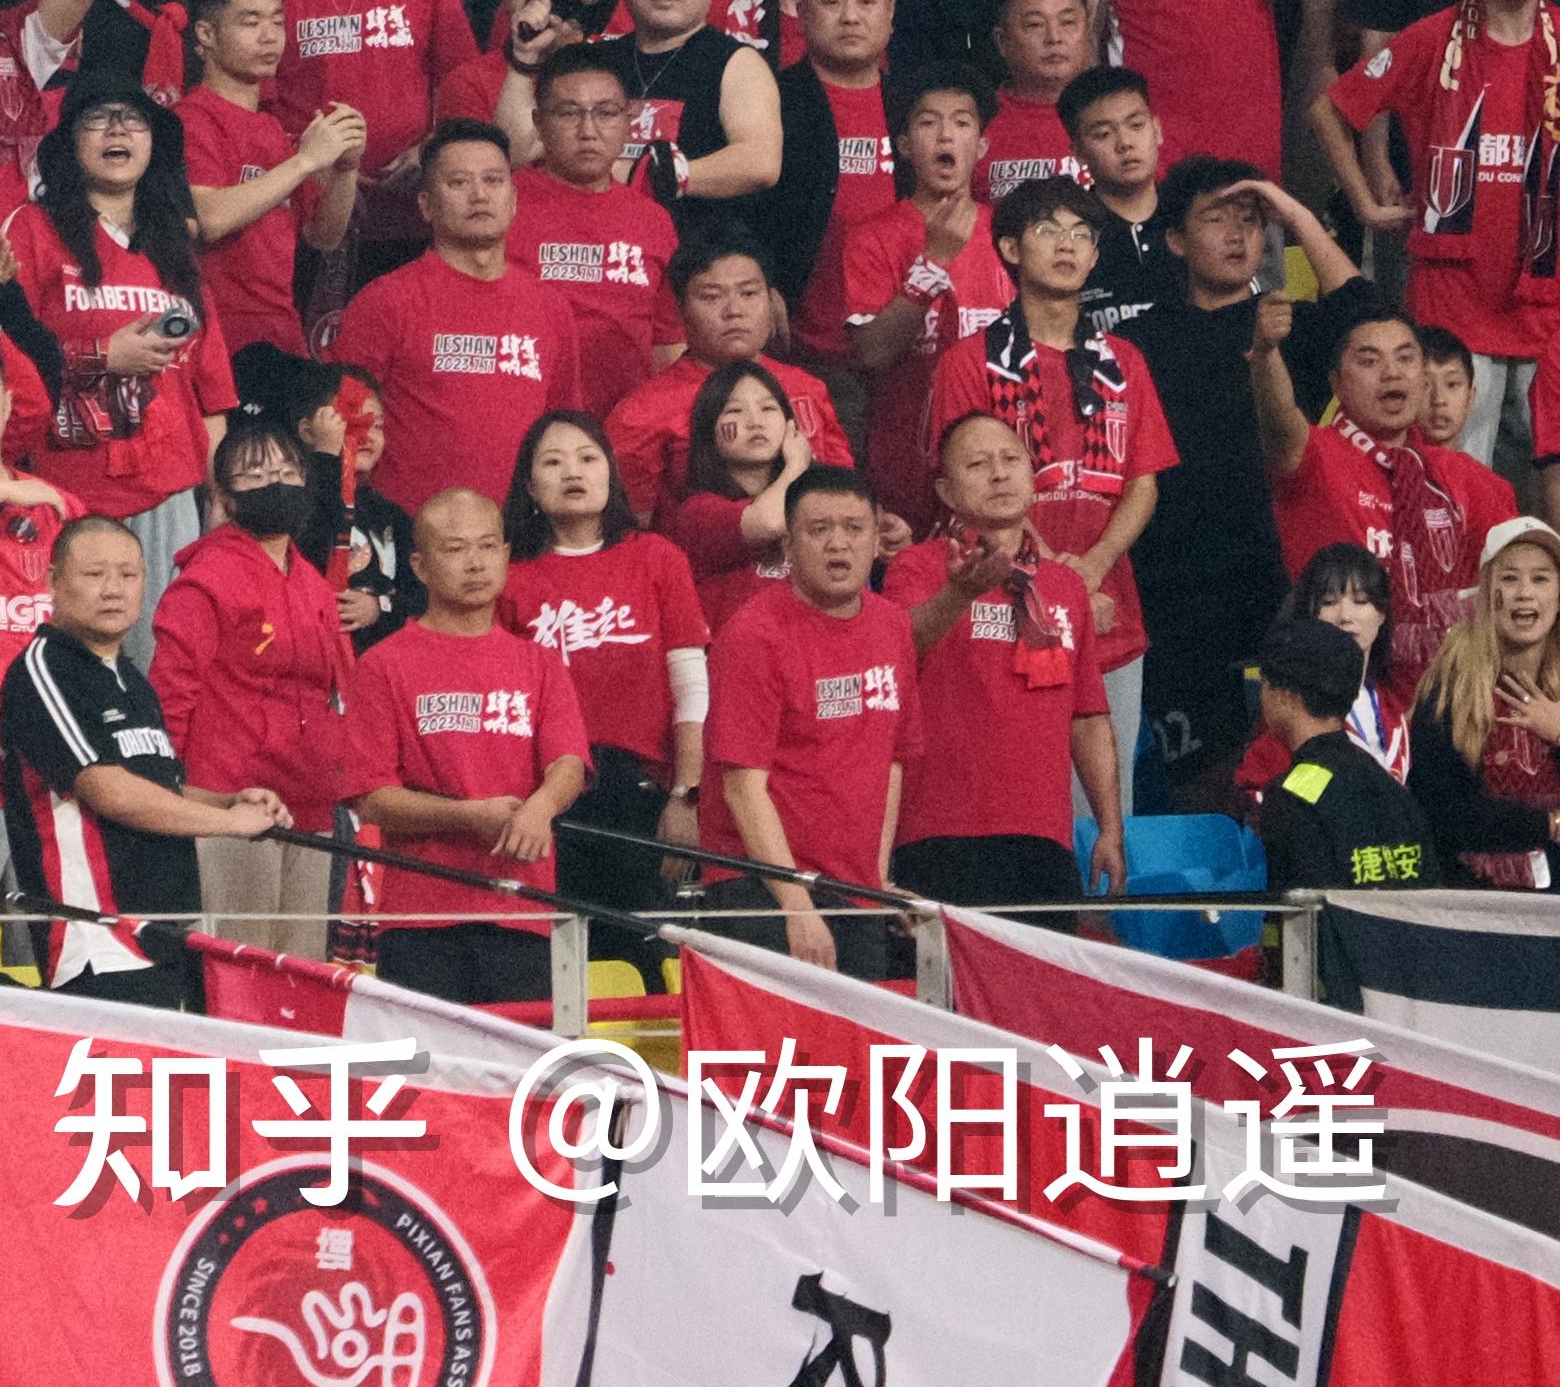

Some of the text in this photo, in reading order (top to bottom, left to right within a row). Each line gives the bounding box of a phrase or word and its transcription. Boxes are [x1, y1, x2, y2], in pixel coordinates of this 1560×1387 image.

[298, 15, 360, 41] LESHAN
[539, 244, 602, 263] LESHAN
[434, 335, 496, 354] LESHAN
[529, 598, 651, 665] 雄起
[817, 674, 862, 698] LESHAN
[416, 692, 483, 716] LESHAN
[396, 1211, 470, 1326] PIXIAN FANS
[179, 1258, 215, 1379] SINCE 2018
